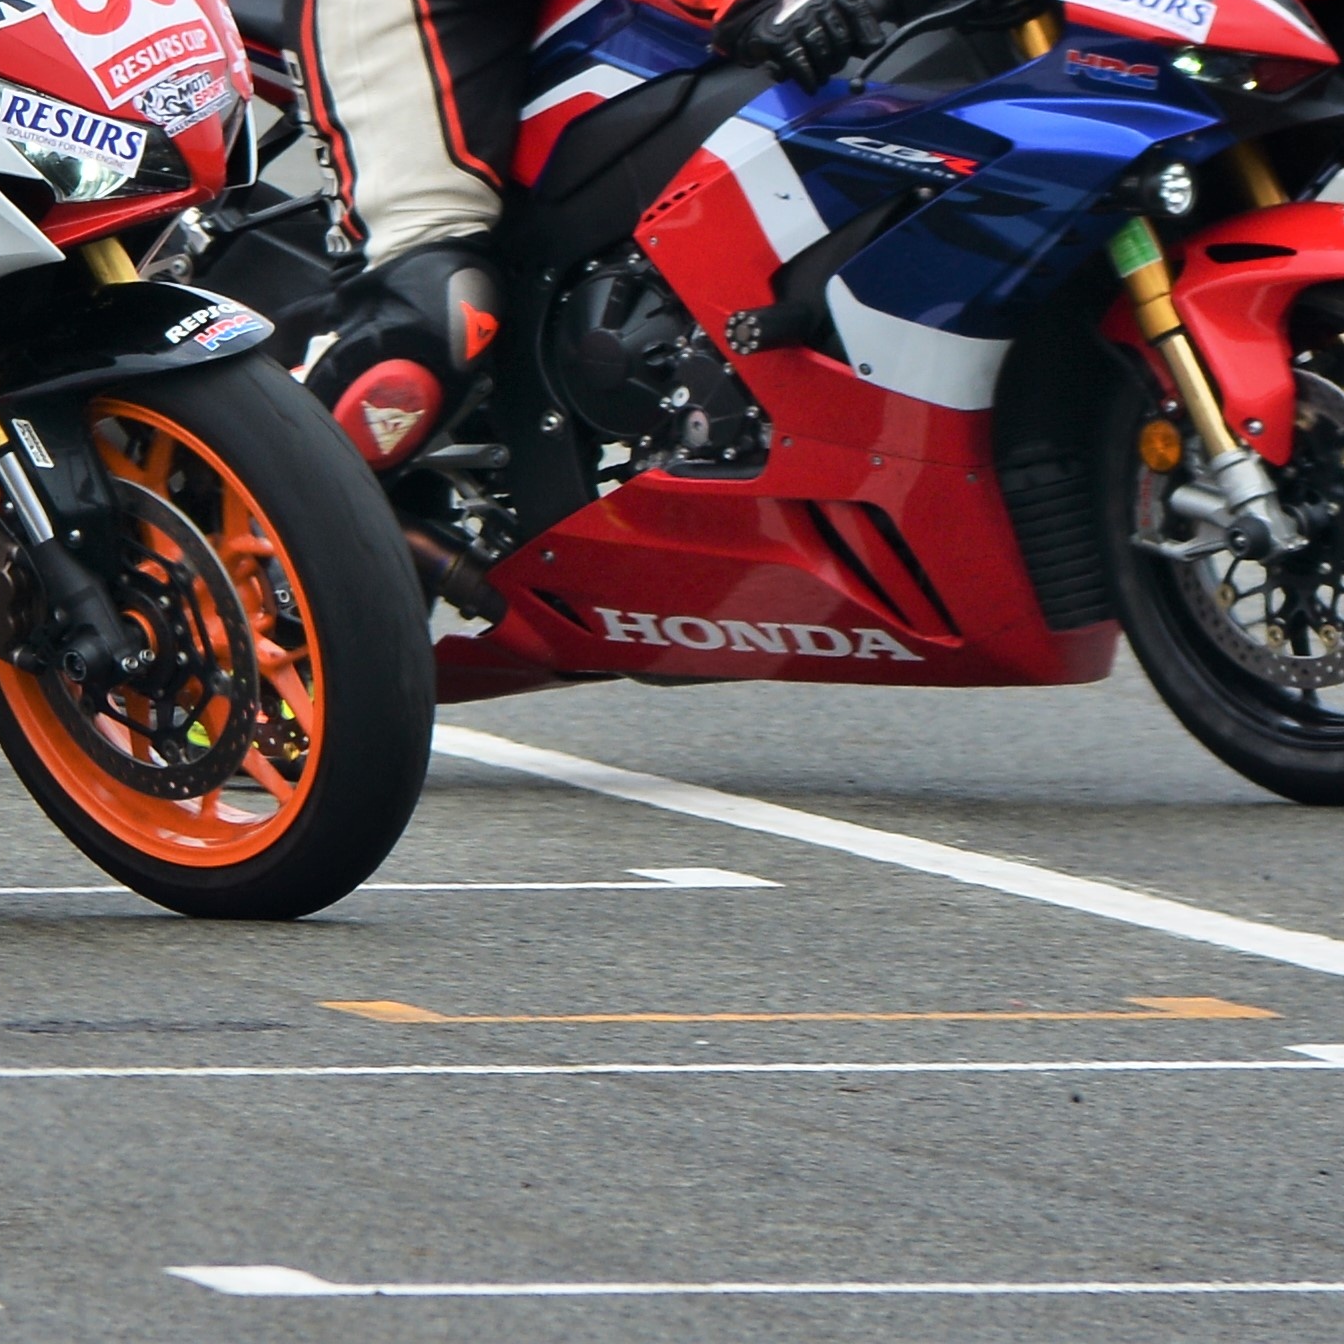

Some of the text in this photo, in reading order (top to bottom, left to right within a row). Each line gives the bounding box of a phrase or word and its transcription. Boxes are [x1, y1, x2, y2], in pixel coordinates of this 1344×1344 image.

[109, 34, 184, 89] RESURS
[181, 28, 208, 51] CUP
[1066, 49, 1159, 90] HRC
[177, 71, 213, 100] MOTO
[2, 94, 143, 161] RESURS
[6, 125, 57, 150] SOLUTIONS
[58, 141, 78, 154] FOR
[77, 145, 96, 159] THE
[835, 136, 980, 176] CBR
[193, 314, 263, 352] HRC
[592, 606, 925, 662] HONDA
